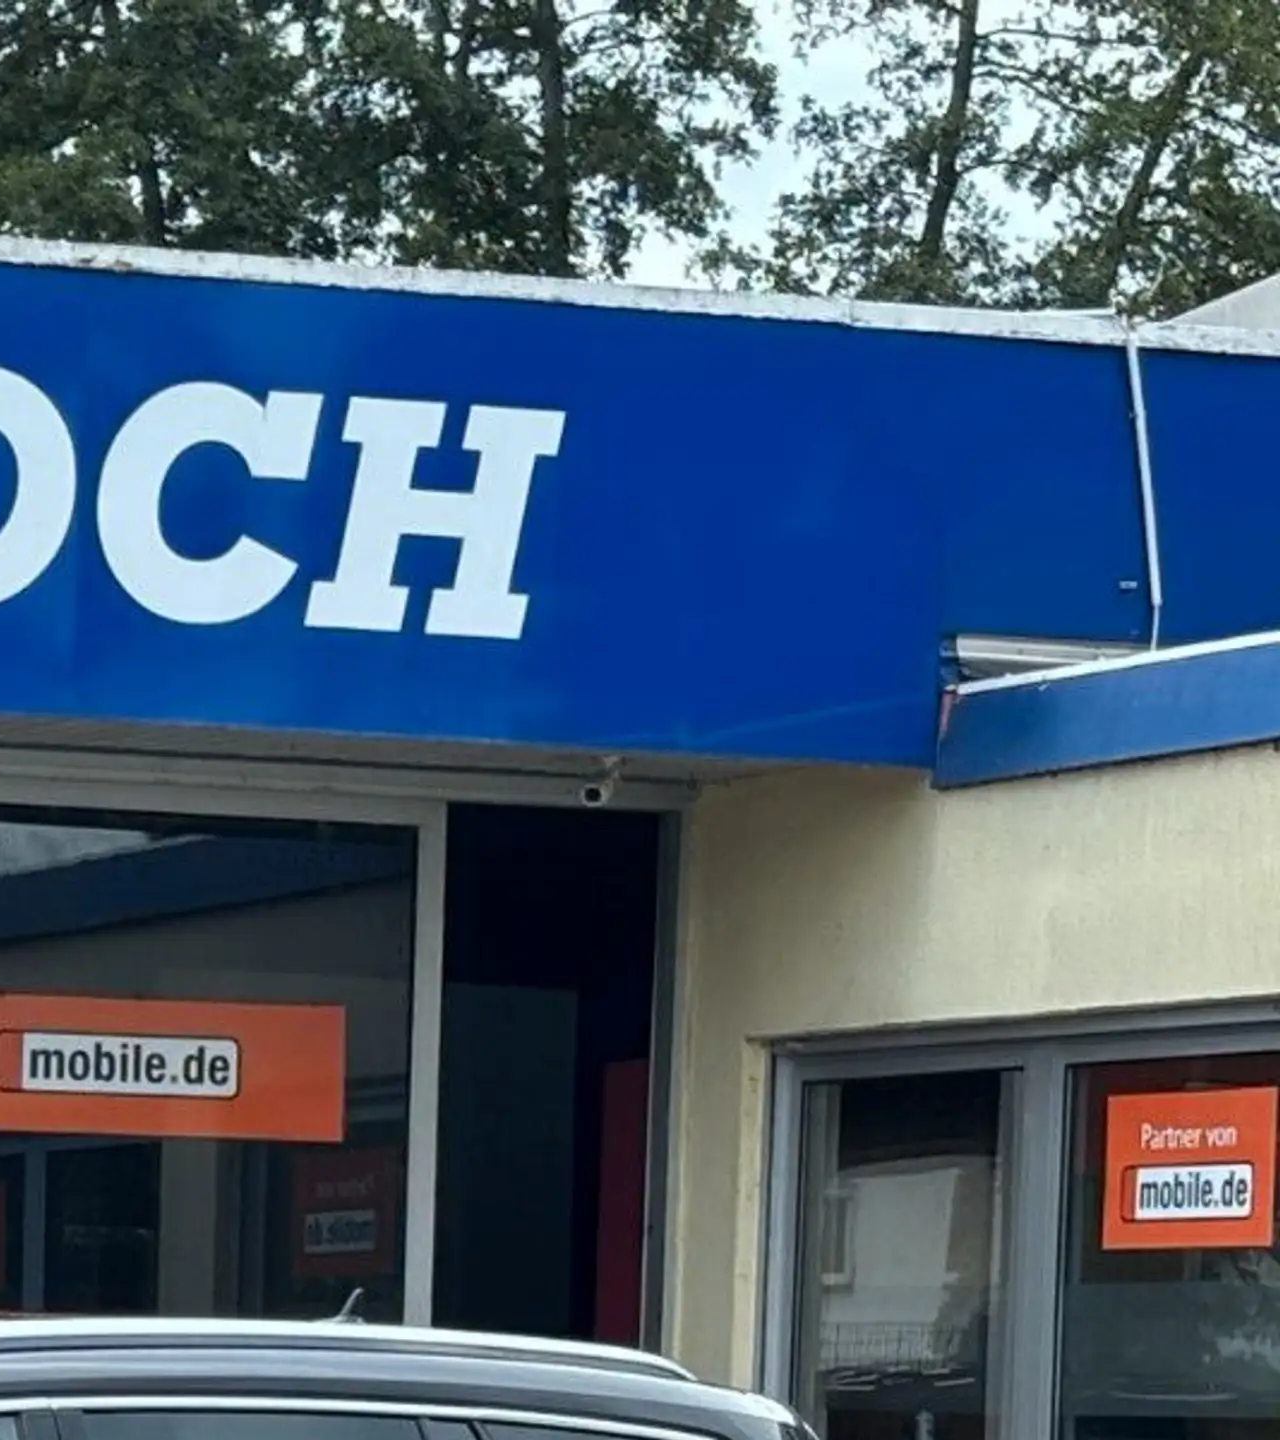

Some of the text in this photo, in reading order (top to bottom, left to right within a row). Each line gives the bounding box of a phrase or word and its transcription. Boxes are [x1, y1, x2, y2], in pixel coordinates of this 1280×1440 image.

[29, 1042, 231, 1086] mobile.de
[1140, 1122, 1237, 1149] Partner von
[1139, 1170, 1248, 1209] mobile.de
